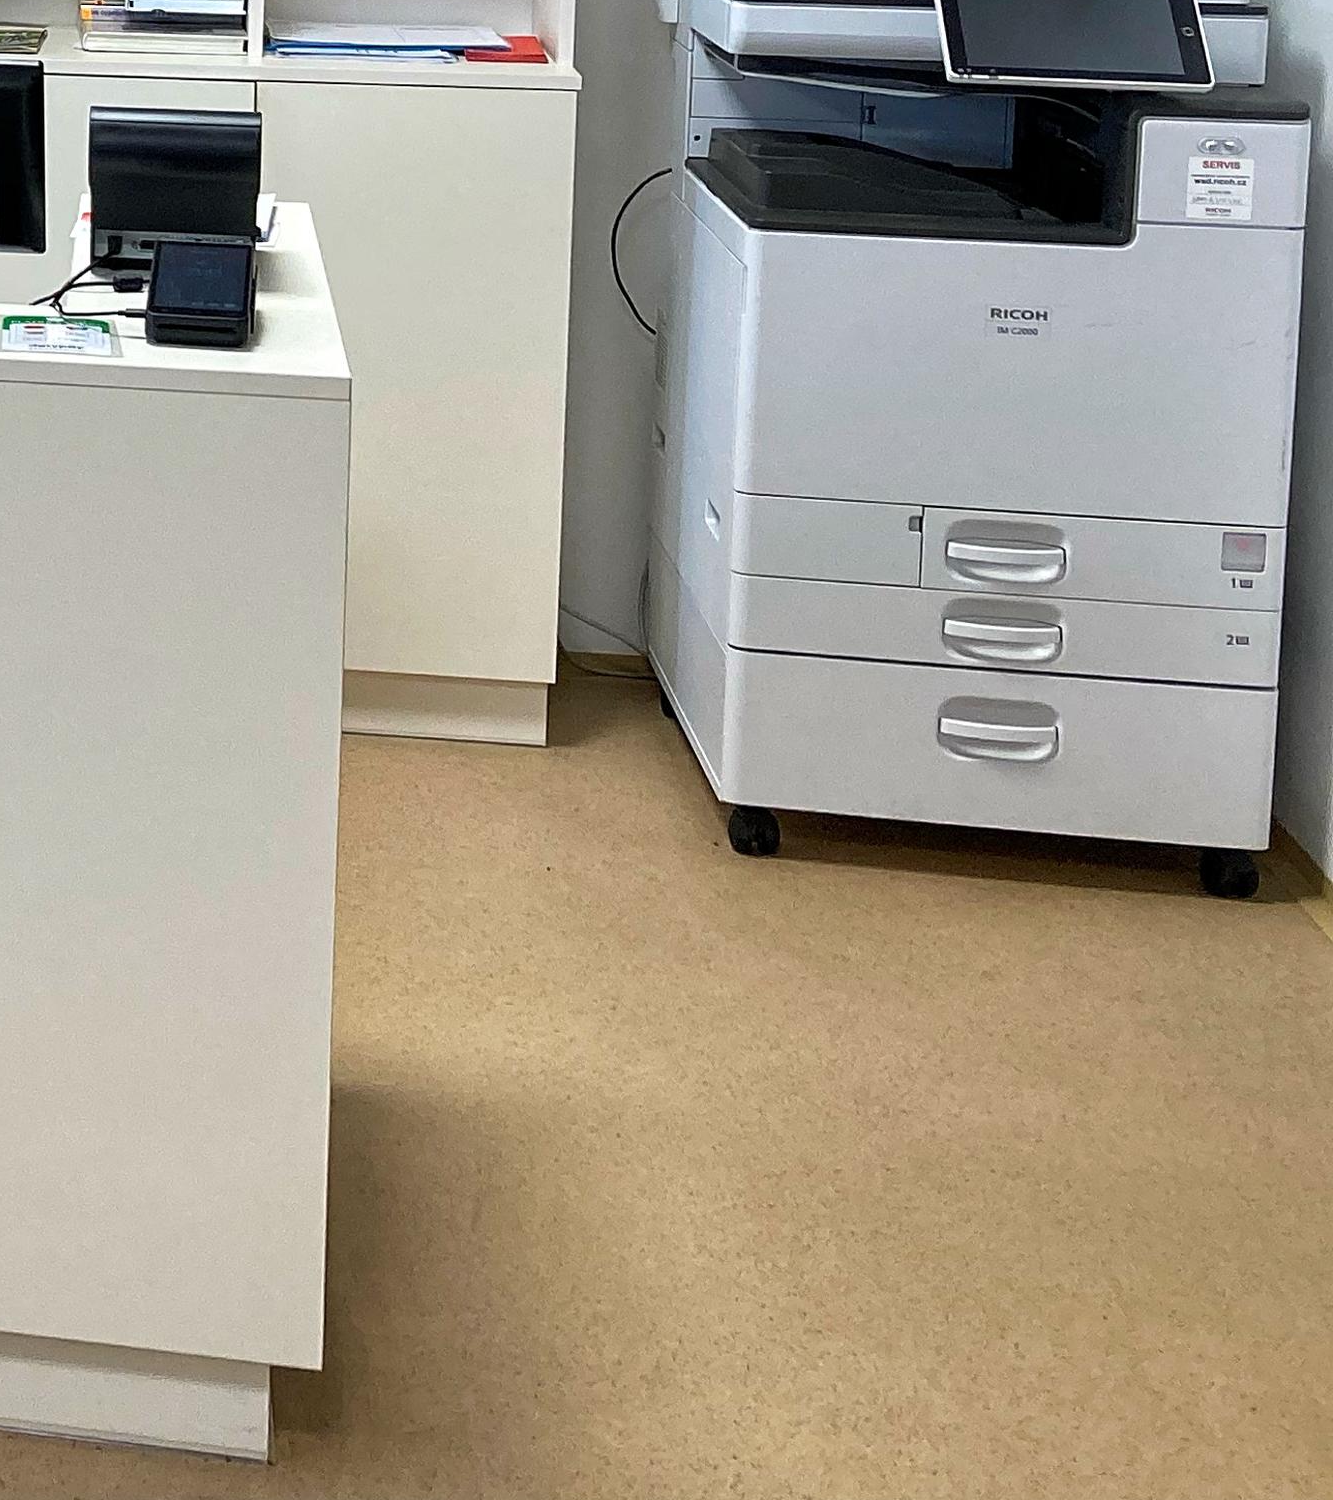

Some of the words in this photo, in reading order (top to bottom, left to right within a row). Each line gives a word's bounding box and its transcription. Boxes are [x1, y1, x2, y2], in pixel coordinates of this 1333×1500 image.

[1202, 160, 1241, 170] SERVIS
[990, 308, 1048, 321] RICOH
[1226, 634, 1235, 646] 2
